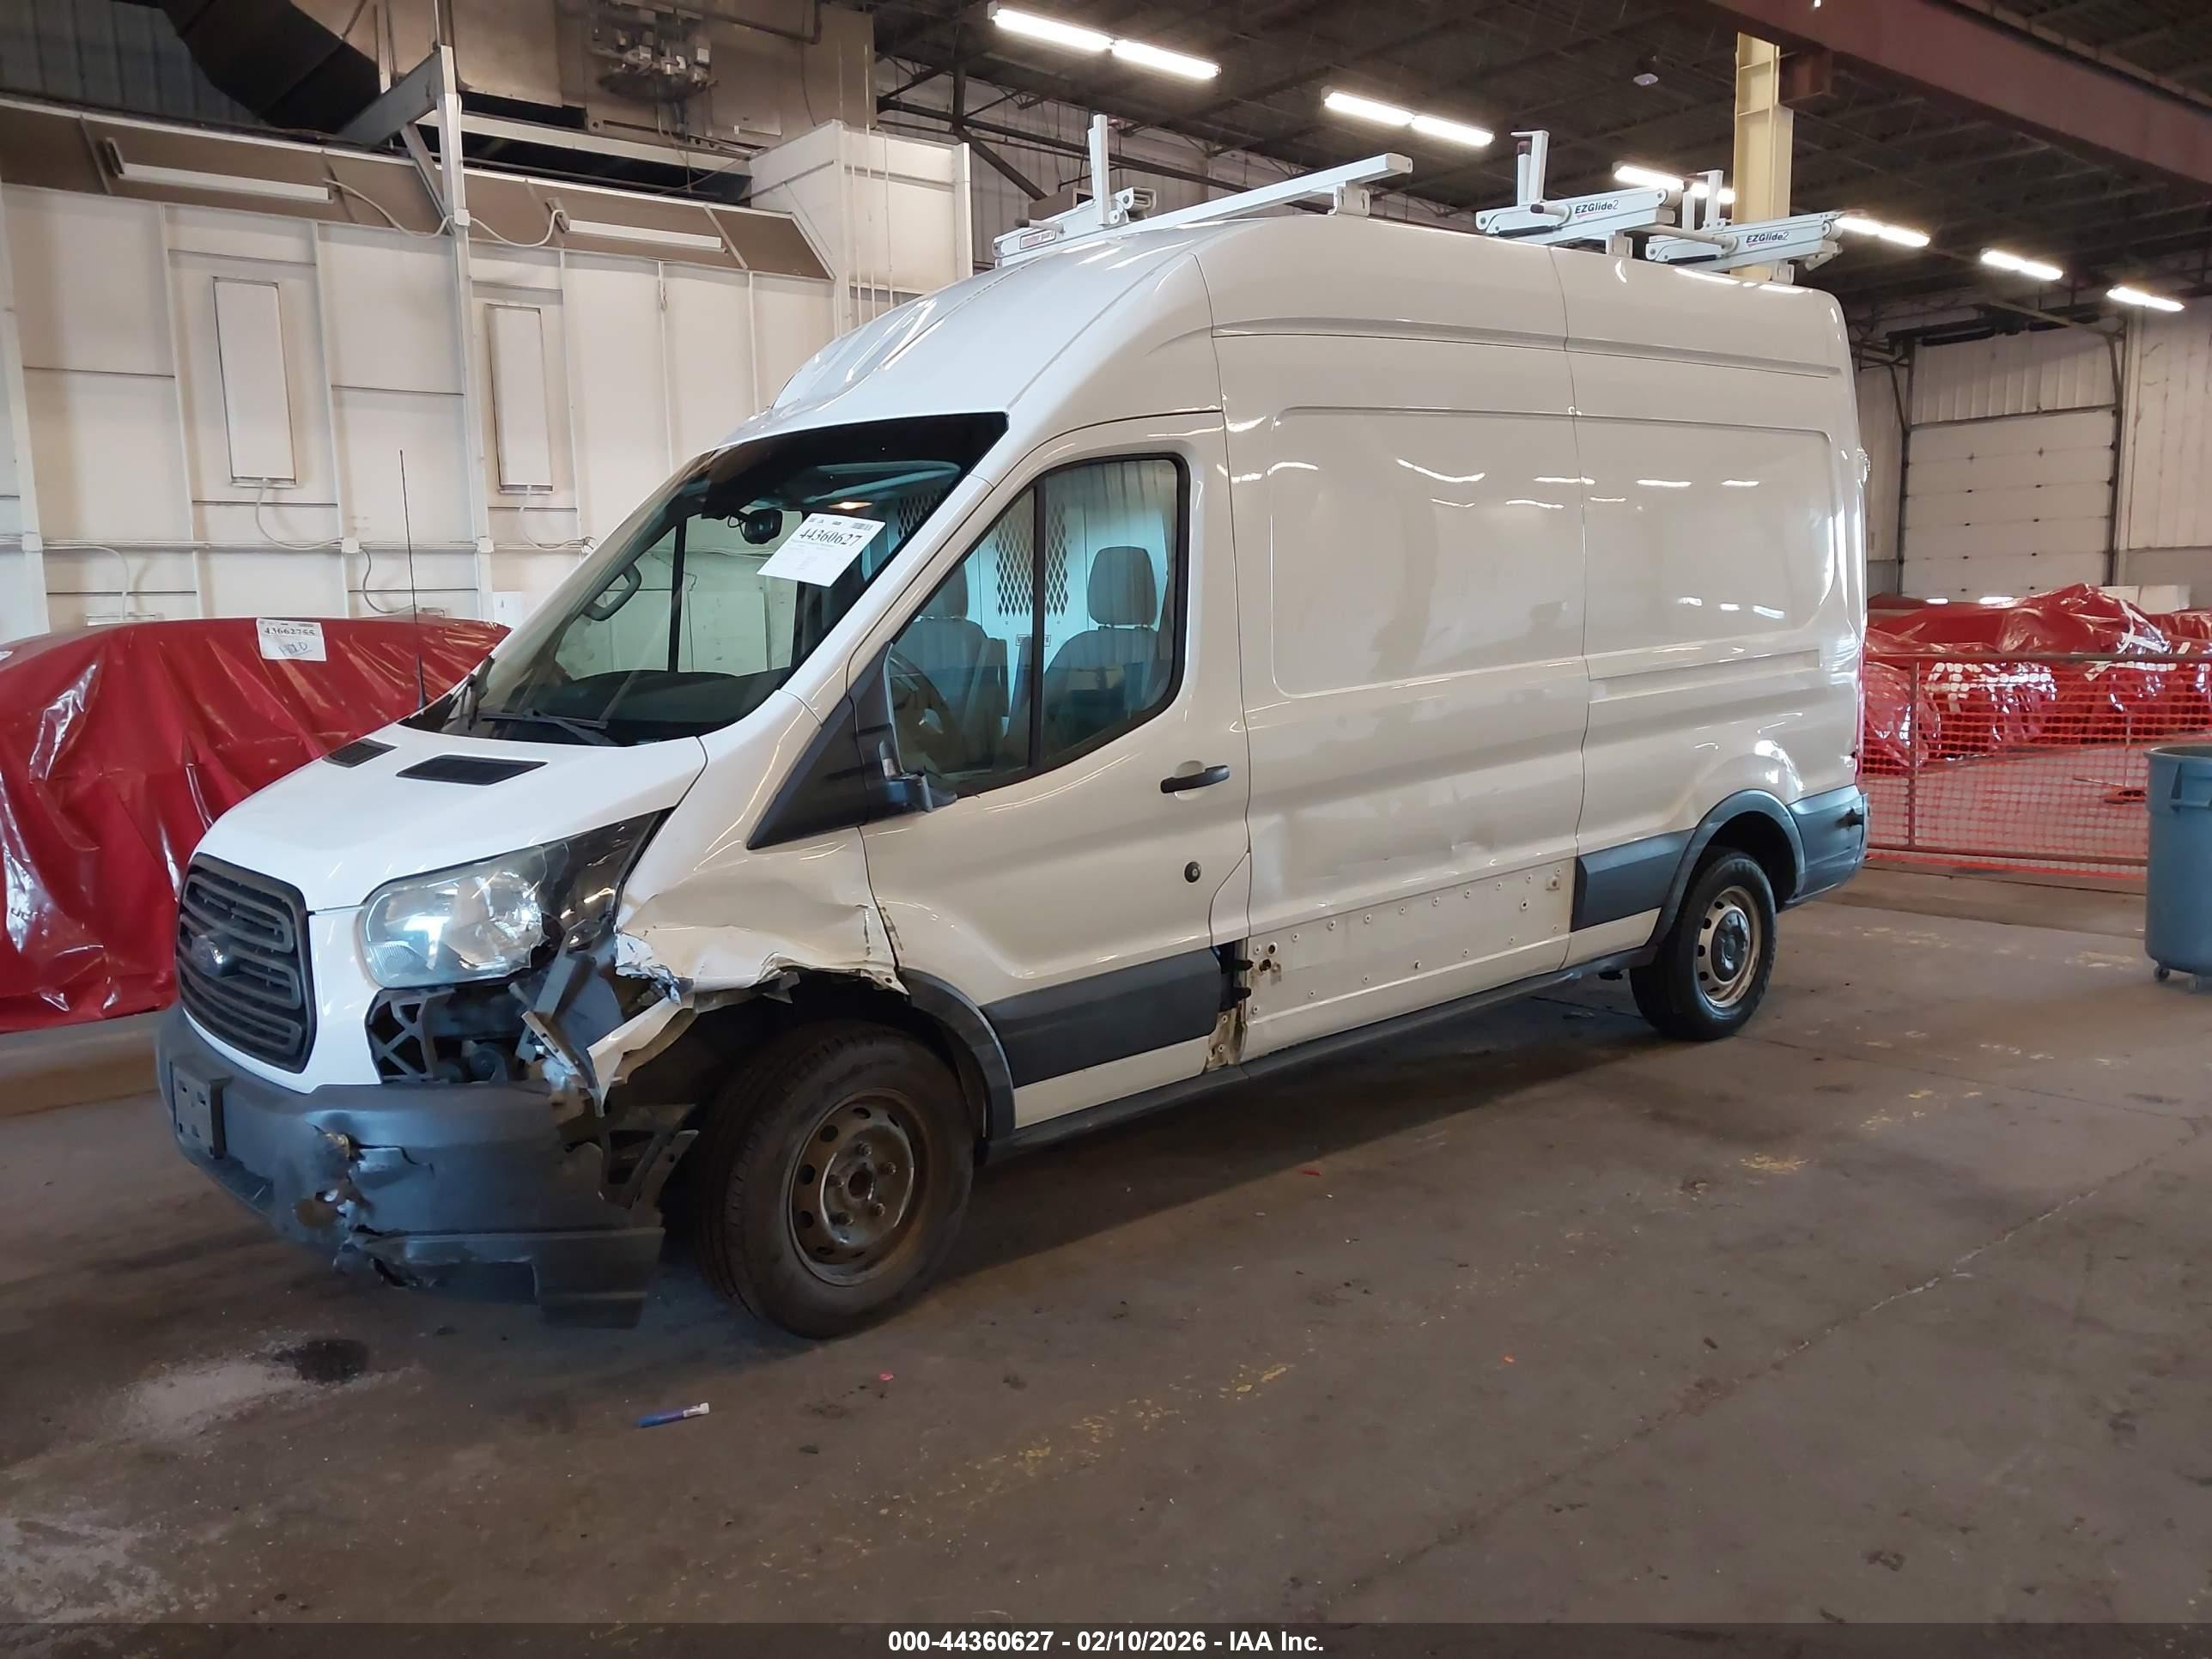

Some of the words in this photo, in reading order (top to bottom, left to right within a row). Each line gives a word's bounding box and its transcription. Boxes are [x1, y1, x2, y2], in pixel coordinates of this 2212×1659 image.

[1575, 199, 1619, 214] EZGlide2
[1746, 231, 1789, 244] EZGlide2
[799, 528, 863, 546] 44360627
